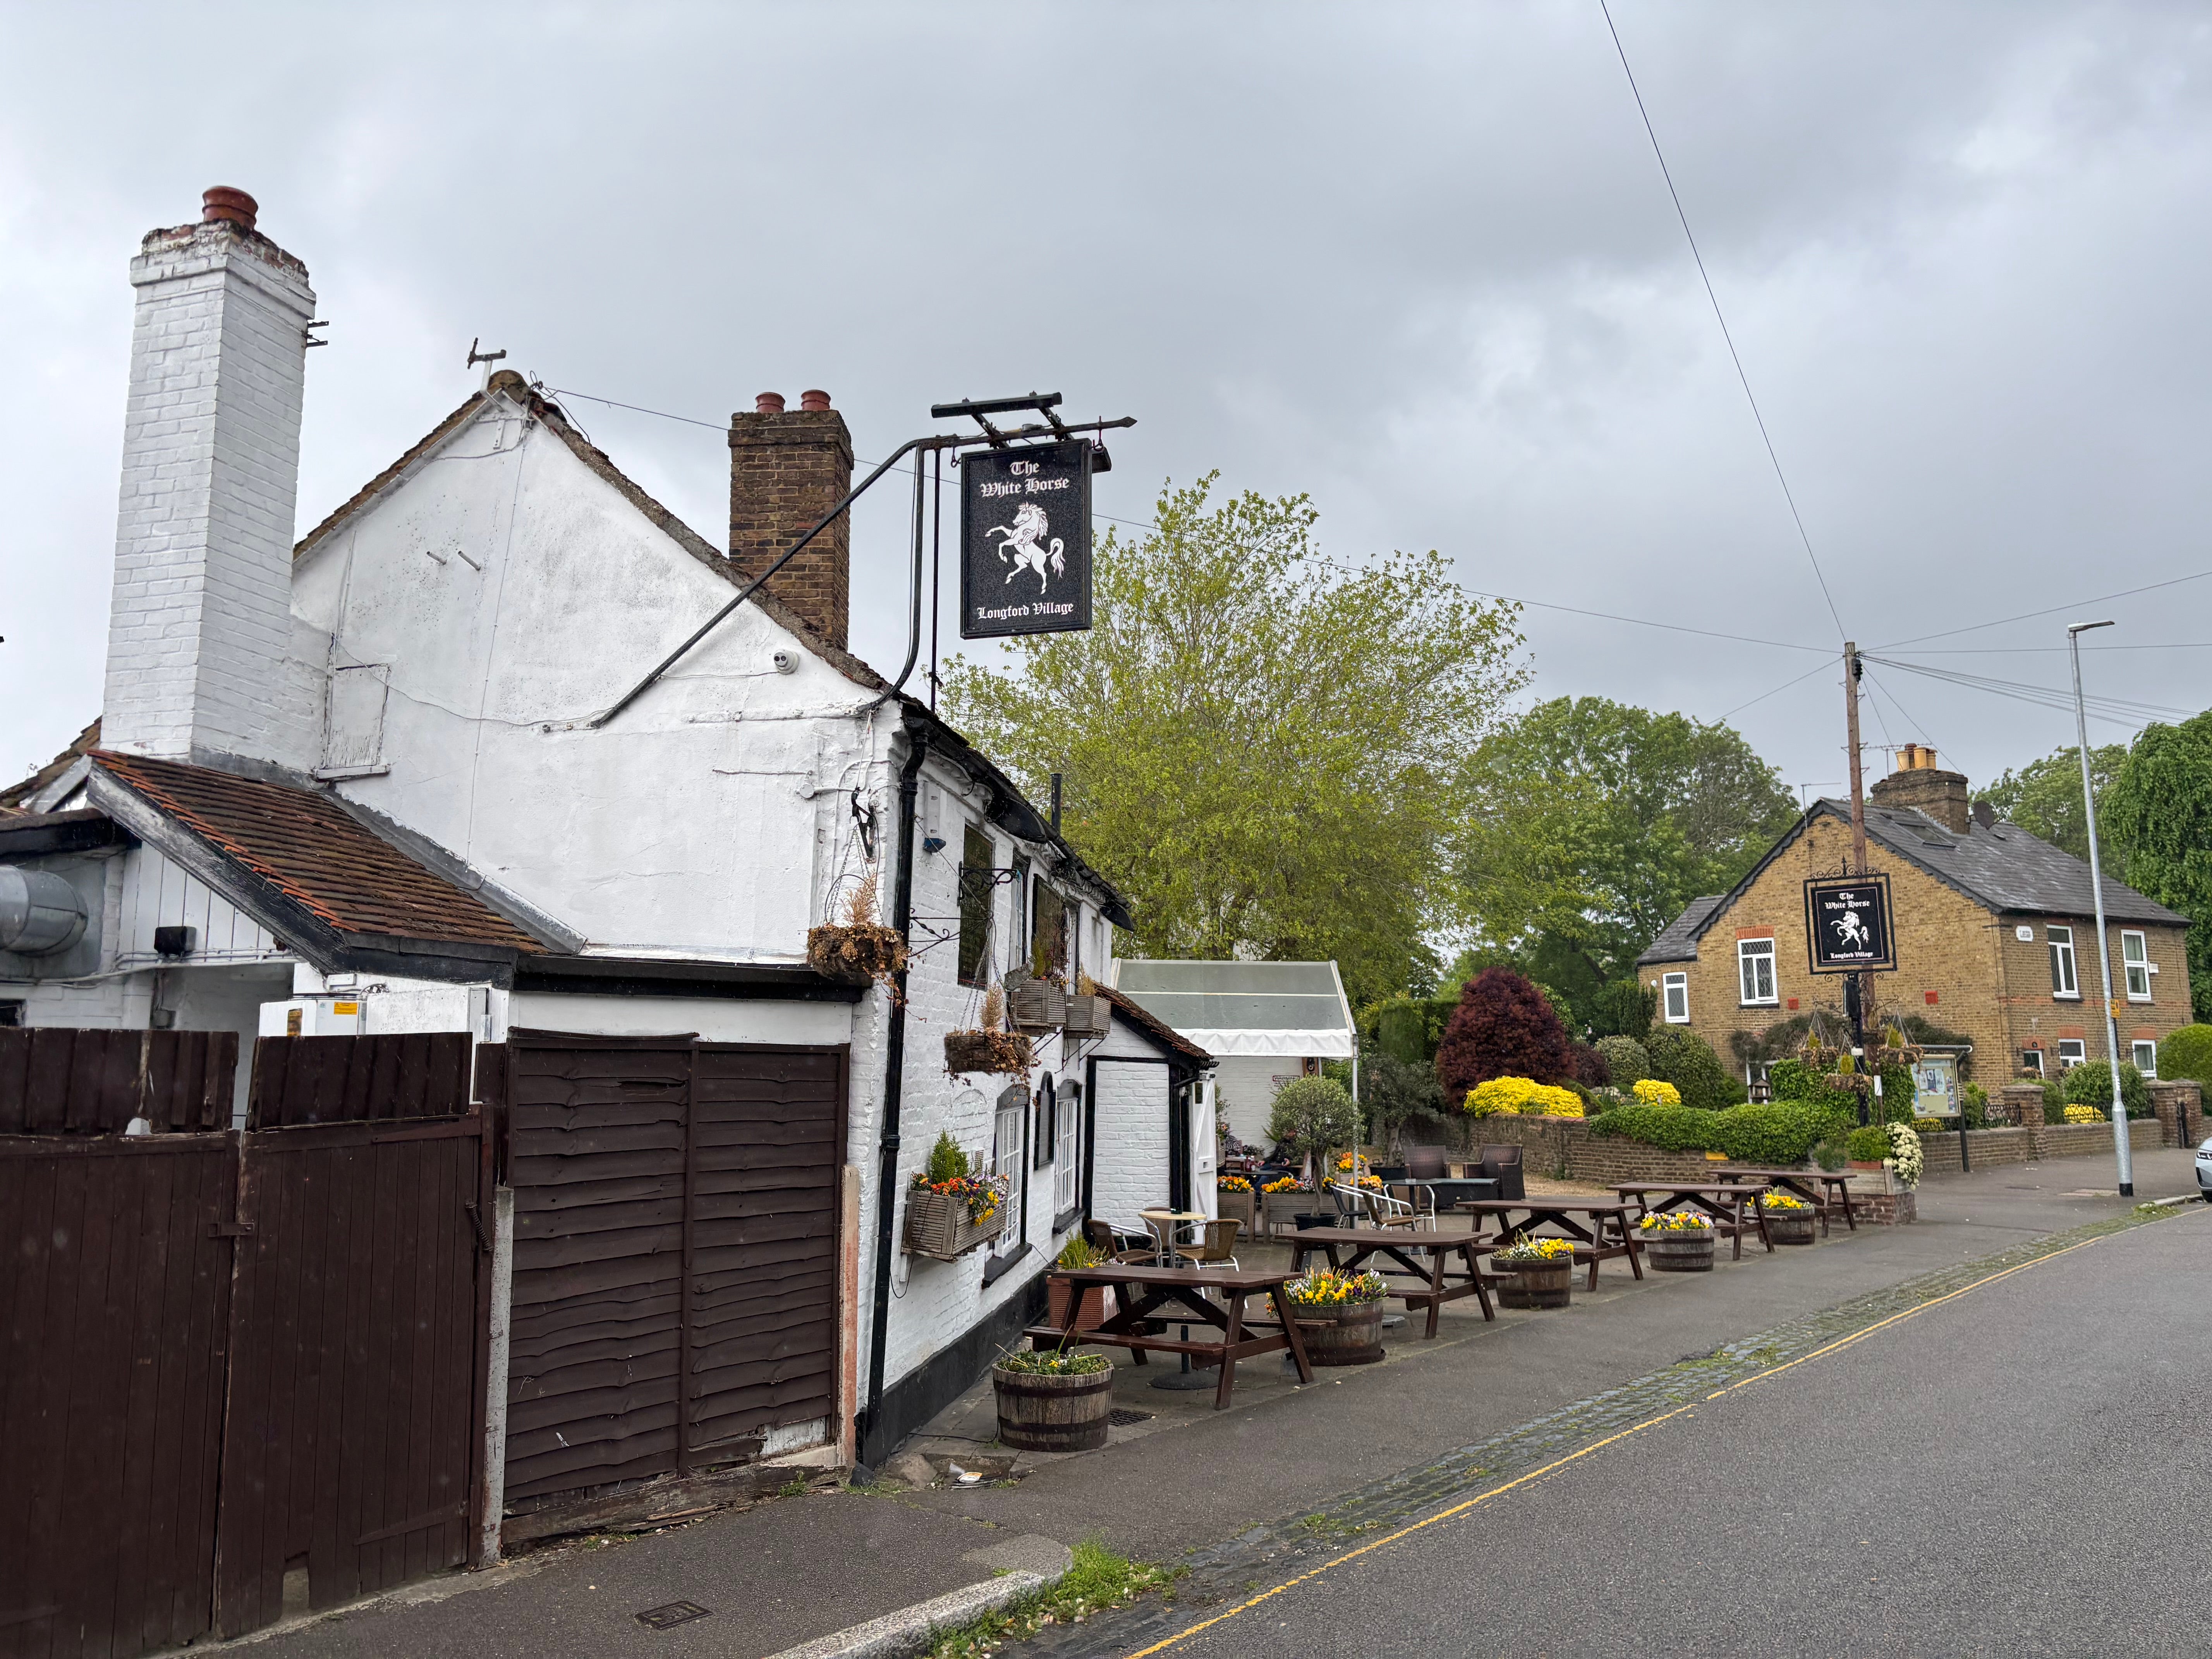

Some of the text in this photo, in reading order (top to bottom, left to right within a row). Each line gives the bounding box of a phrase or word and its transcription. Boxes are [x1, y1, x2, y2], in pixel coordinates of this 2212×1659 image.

[1010, 460, 1040, 477] The
[980, 477, 1070, 498] White Horse
[977, 602, 1074, 620] Longford Village
[1847, 900, 1870, 908] Horse
